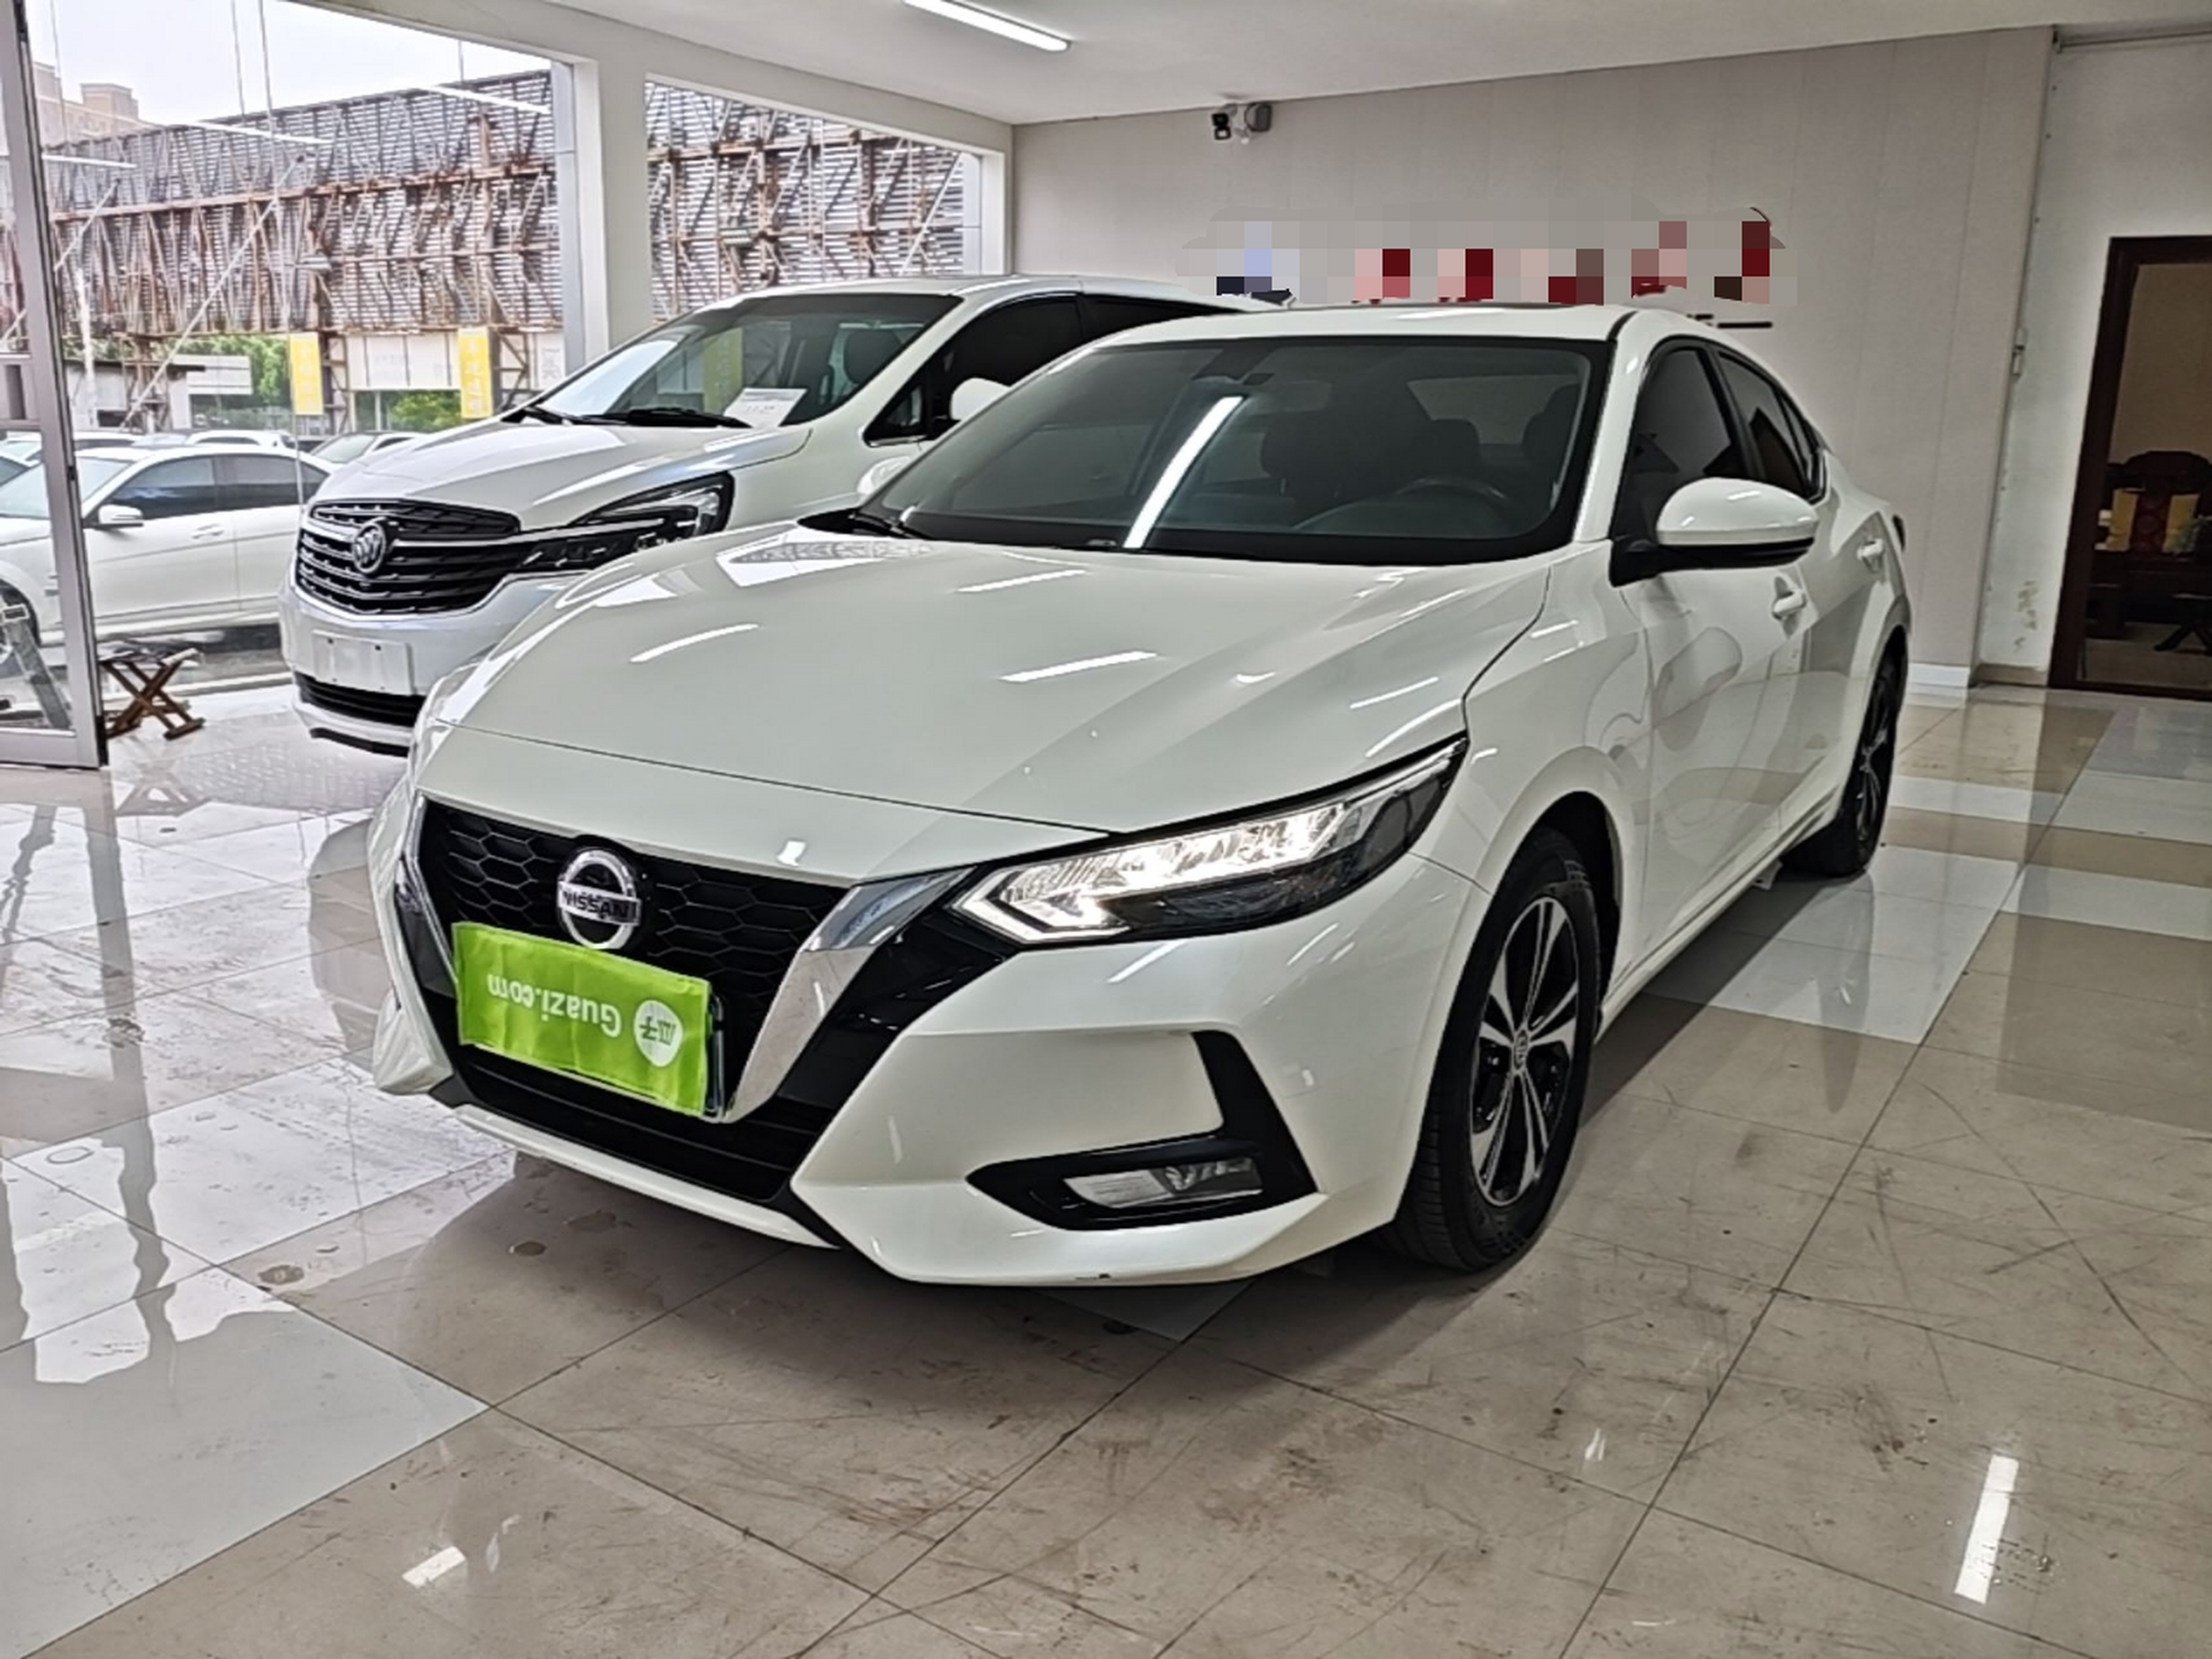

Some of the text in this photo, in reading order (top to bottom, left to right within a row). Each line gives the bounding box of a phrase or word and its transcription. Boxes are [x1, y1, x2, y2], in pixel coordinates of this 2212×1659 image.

[563, 891, 630, 918] NISSAN
[487, 974, 622, 1037] Guazi.com
[639, 1016, 676, 1046] 瓜子
